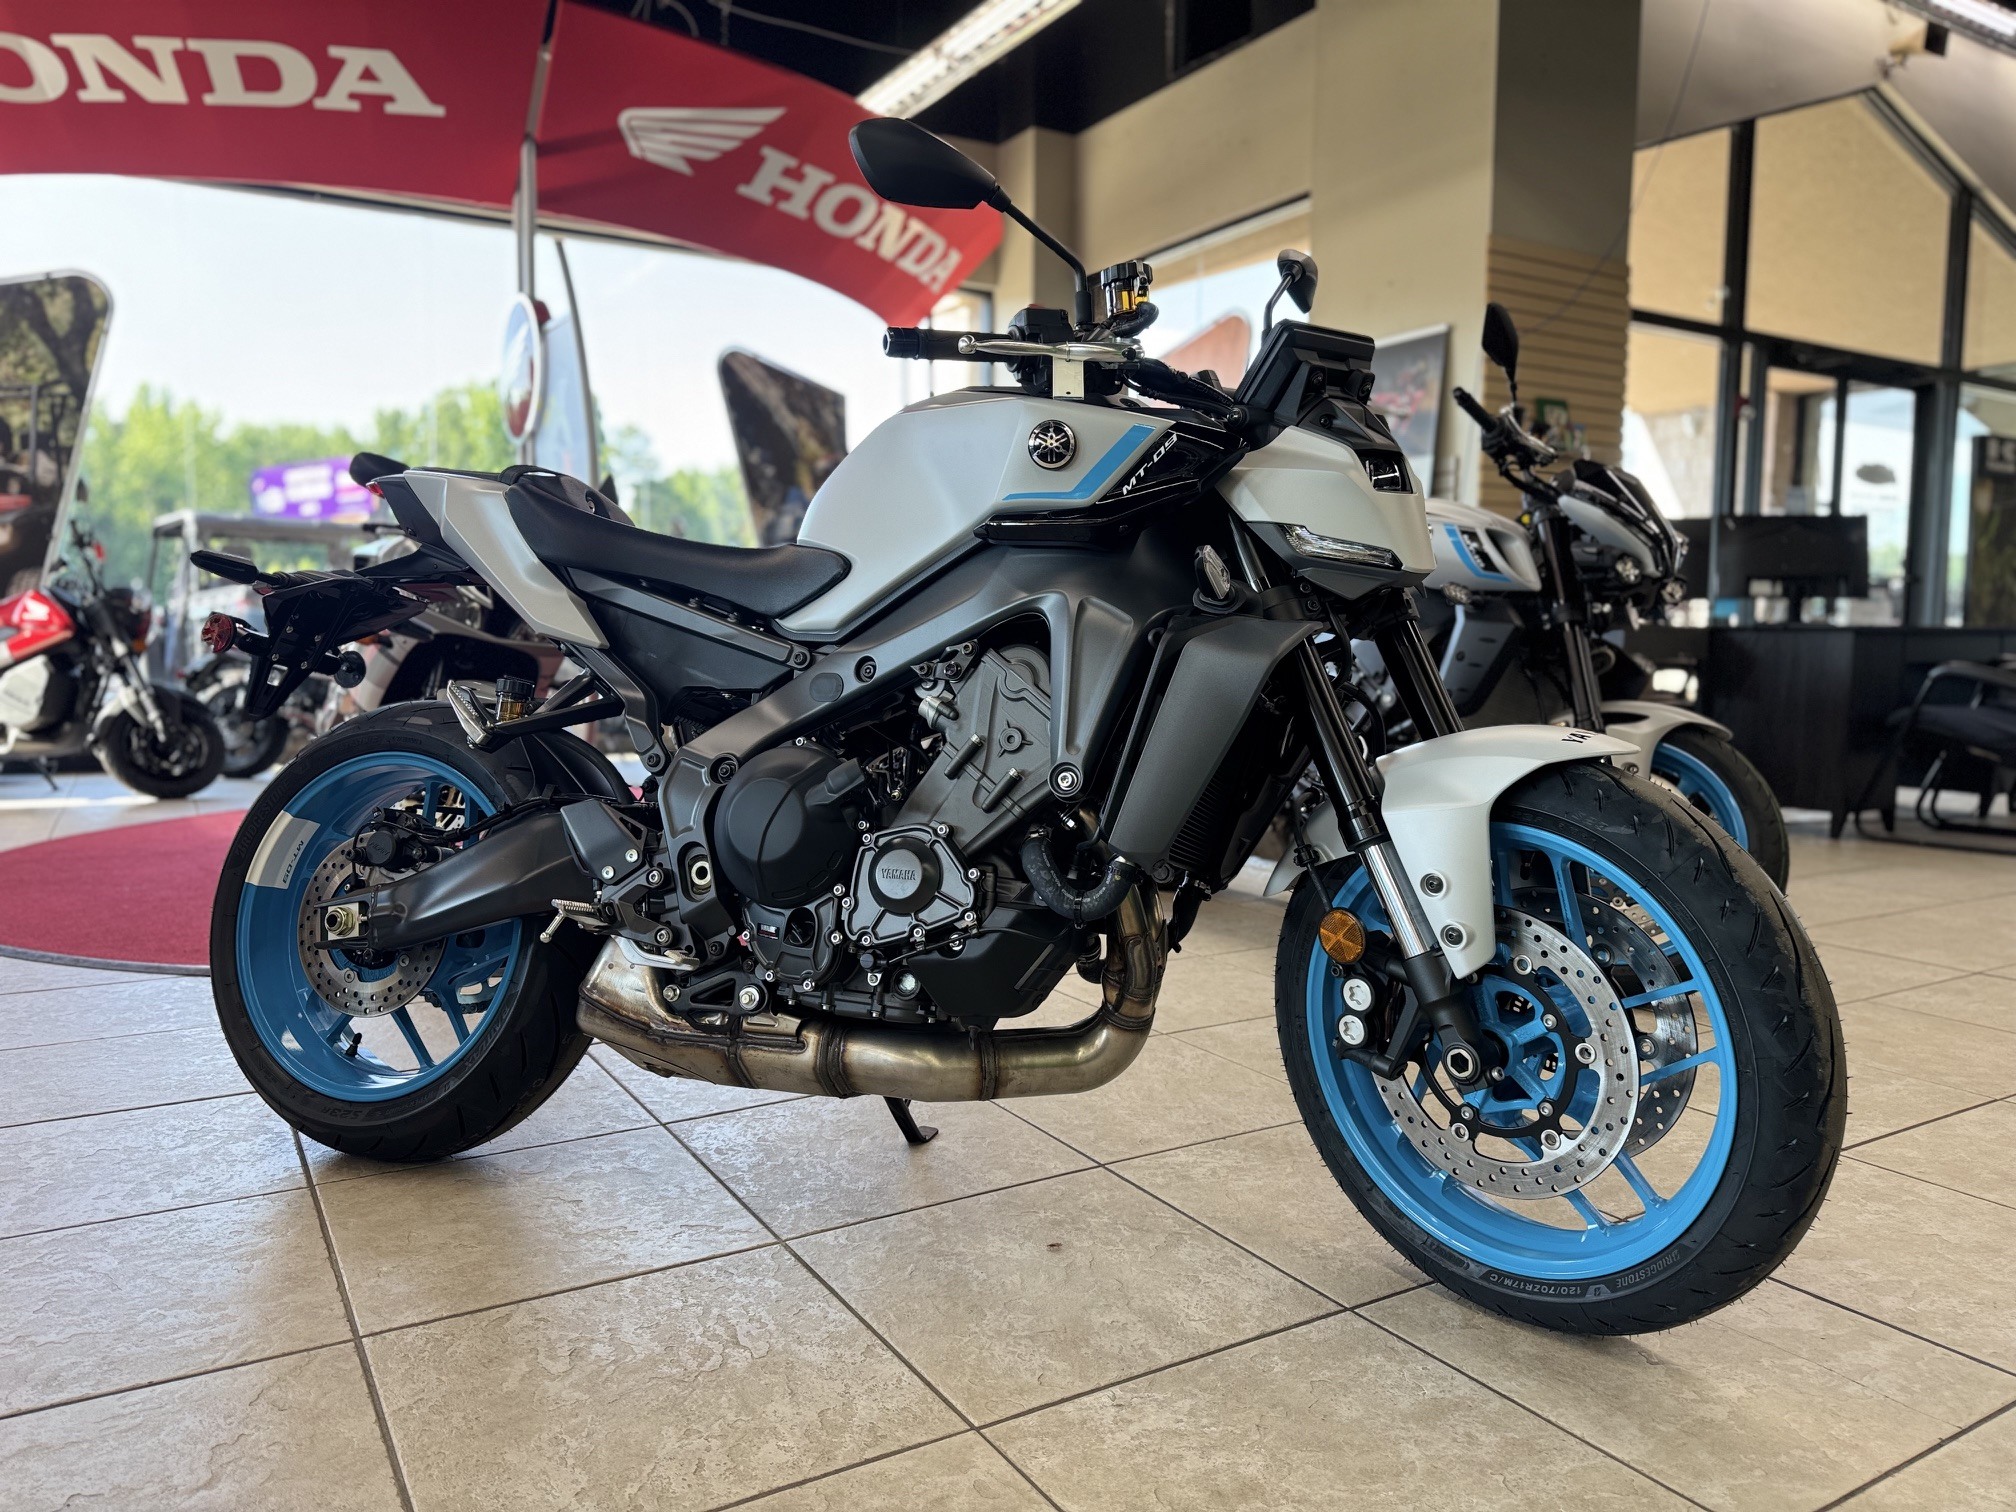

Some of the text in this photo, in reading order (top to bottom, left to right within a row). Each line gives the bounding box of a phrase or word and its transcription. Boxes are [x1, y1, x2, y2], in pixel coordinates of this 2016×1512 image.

[736, 145, 963, 294] HONDA
[1122, 433, 1178, 495] MT-09
[283, 840, 304, 884] MT-09
[881, 868, 916, 881] YAMAHA
[1616, 1249, 1681, 1288] BRIDGESTONE
